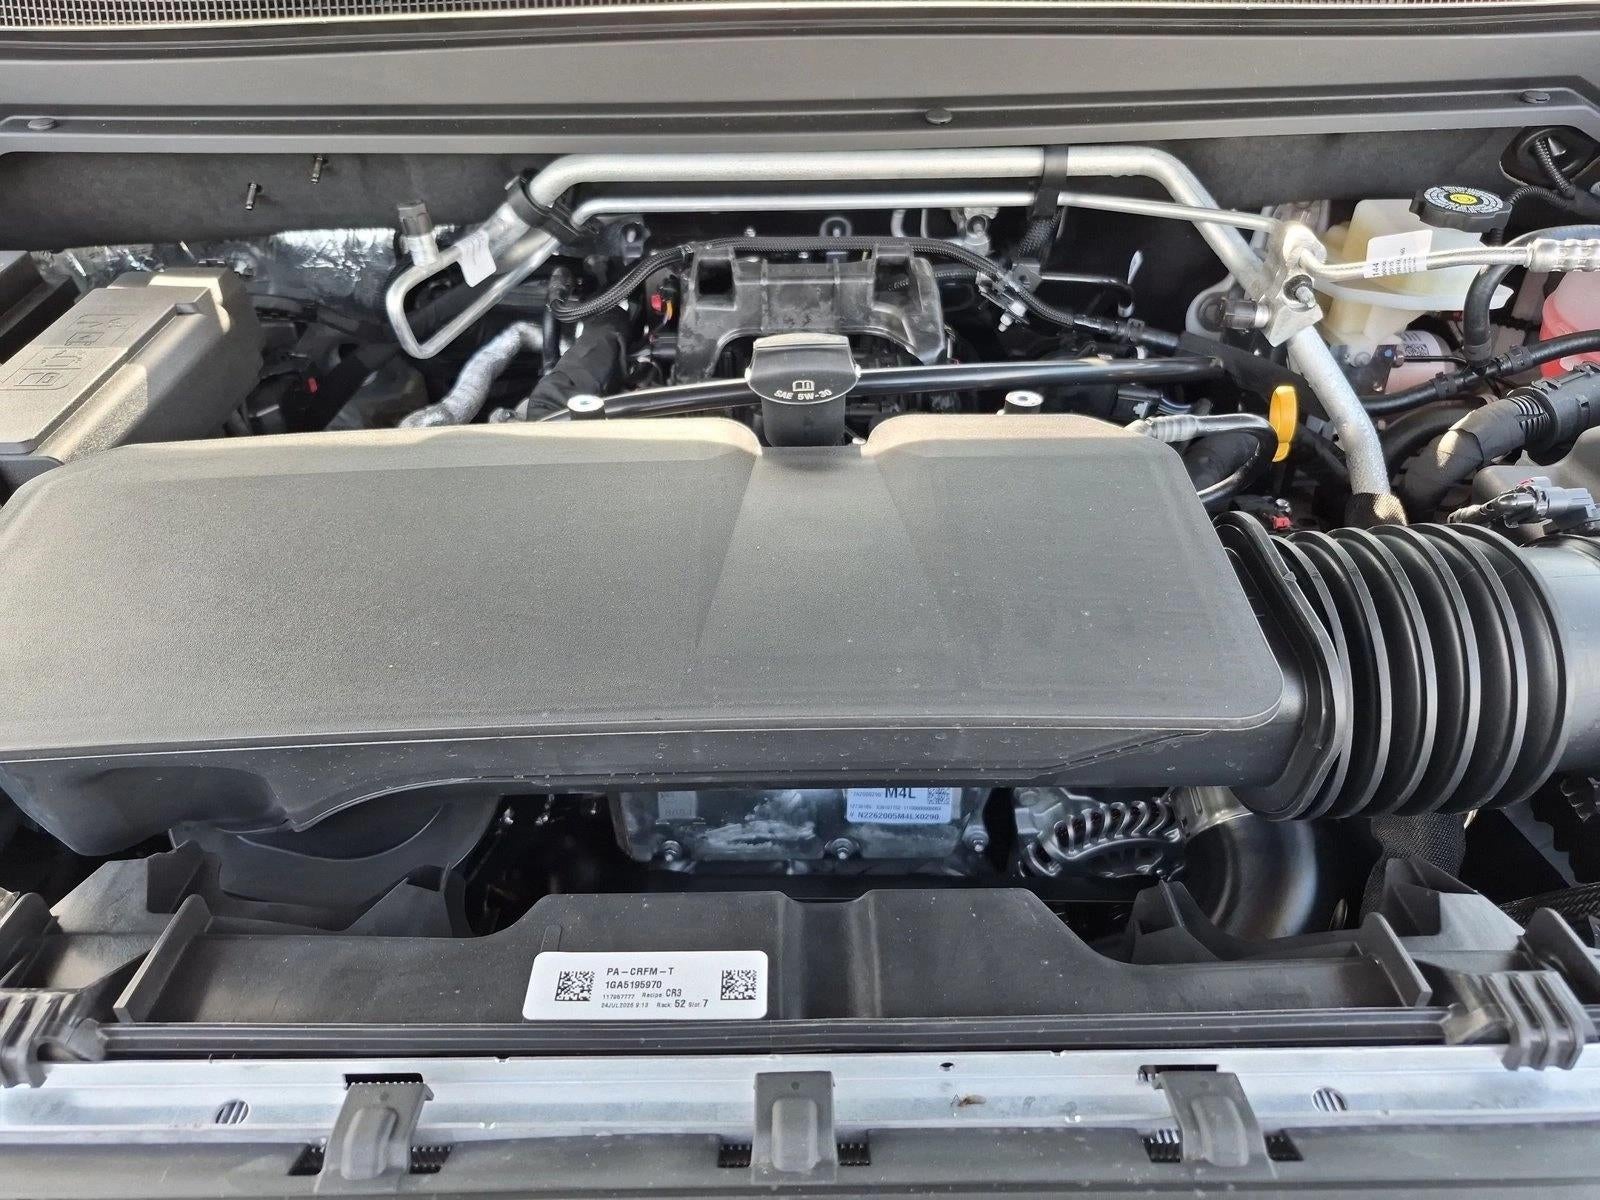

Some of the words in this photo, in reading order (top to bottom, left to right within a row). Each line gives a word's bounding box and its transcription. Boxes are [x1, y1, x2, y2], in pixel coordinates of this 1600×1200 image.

[773, 389, 794, 400] SAE
[797, 389, 833, 400] 5W-30
[885, 787, 916, 799] M4L
[605, 980, 663, 989] 1GA5195970
[665, 988, 683, 997] CR3
[674, 999, 687, 1008] 52
[702, 999, 709, 1008] 7
